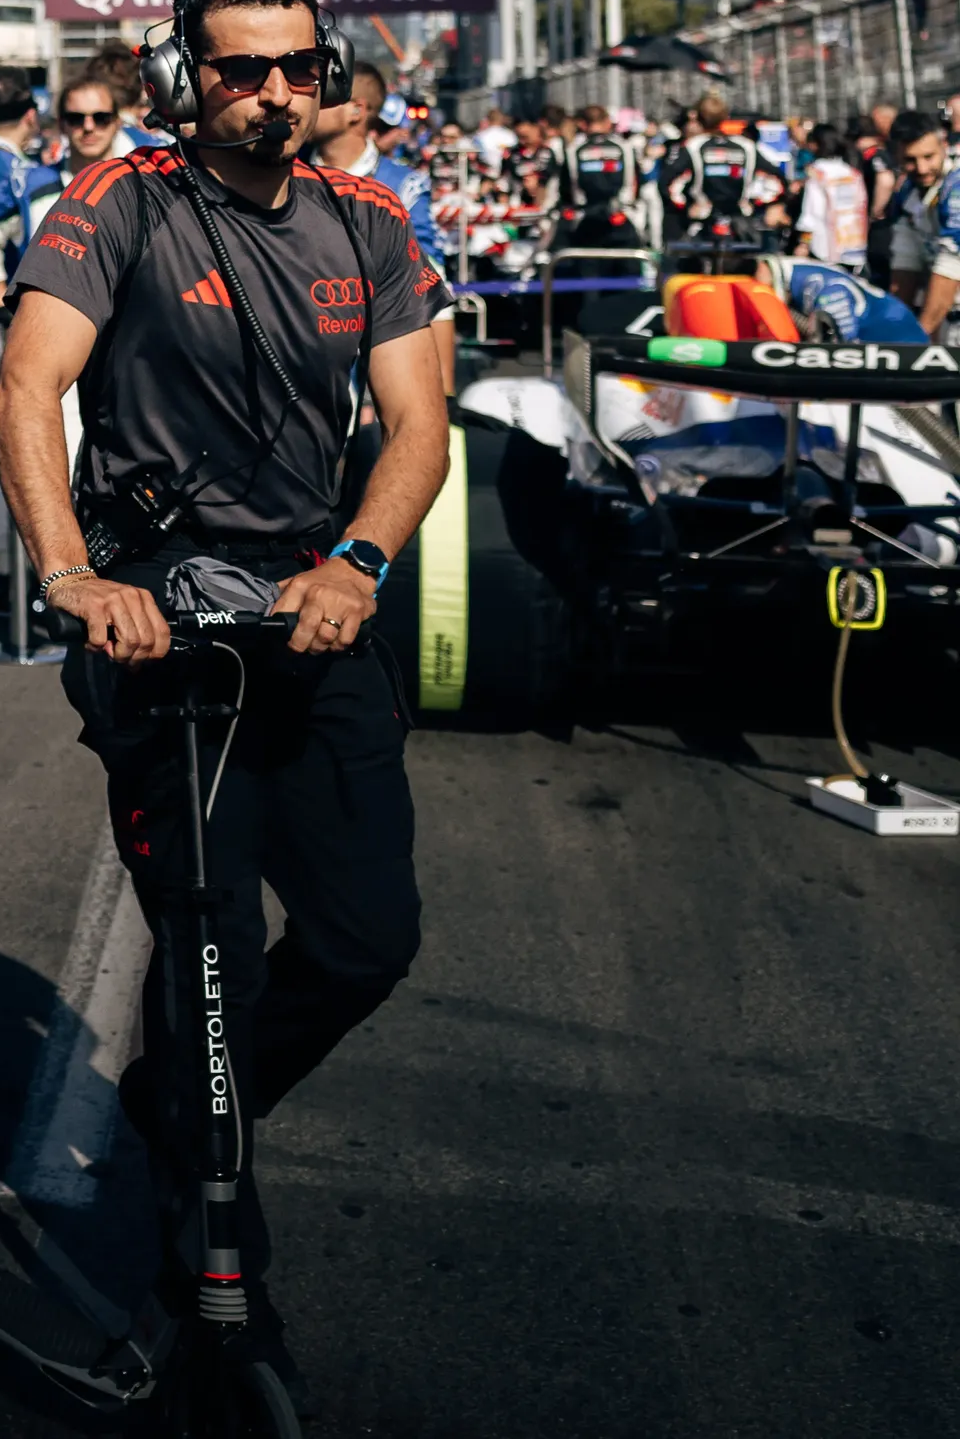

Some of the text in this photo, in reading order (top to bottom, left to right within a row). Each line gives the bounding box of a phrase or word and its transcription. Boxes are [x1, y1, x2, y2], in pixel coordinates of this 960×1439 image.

[751, 341, 901, 371] Cash
[195, 610, 237, 628] perk
[202, 944, 228, 1114] BORTOLETO
